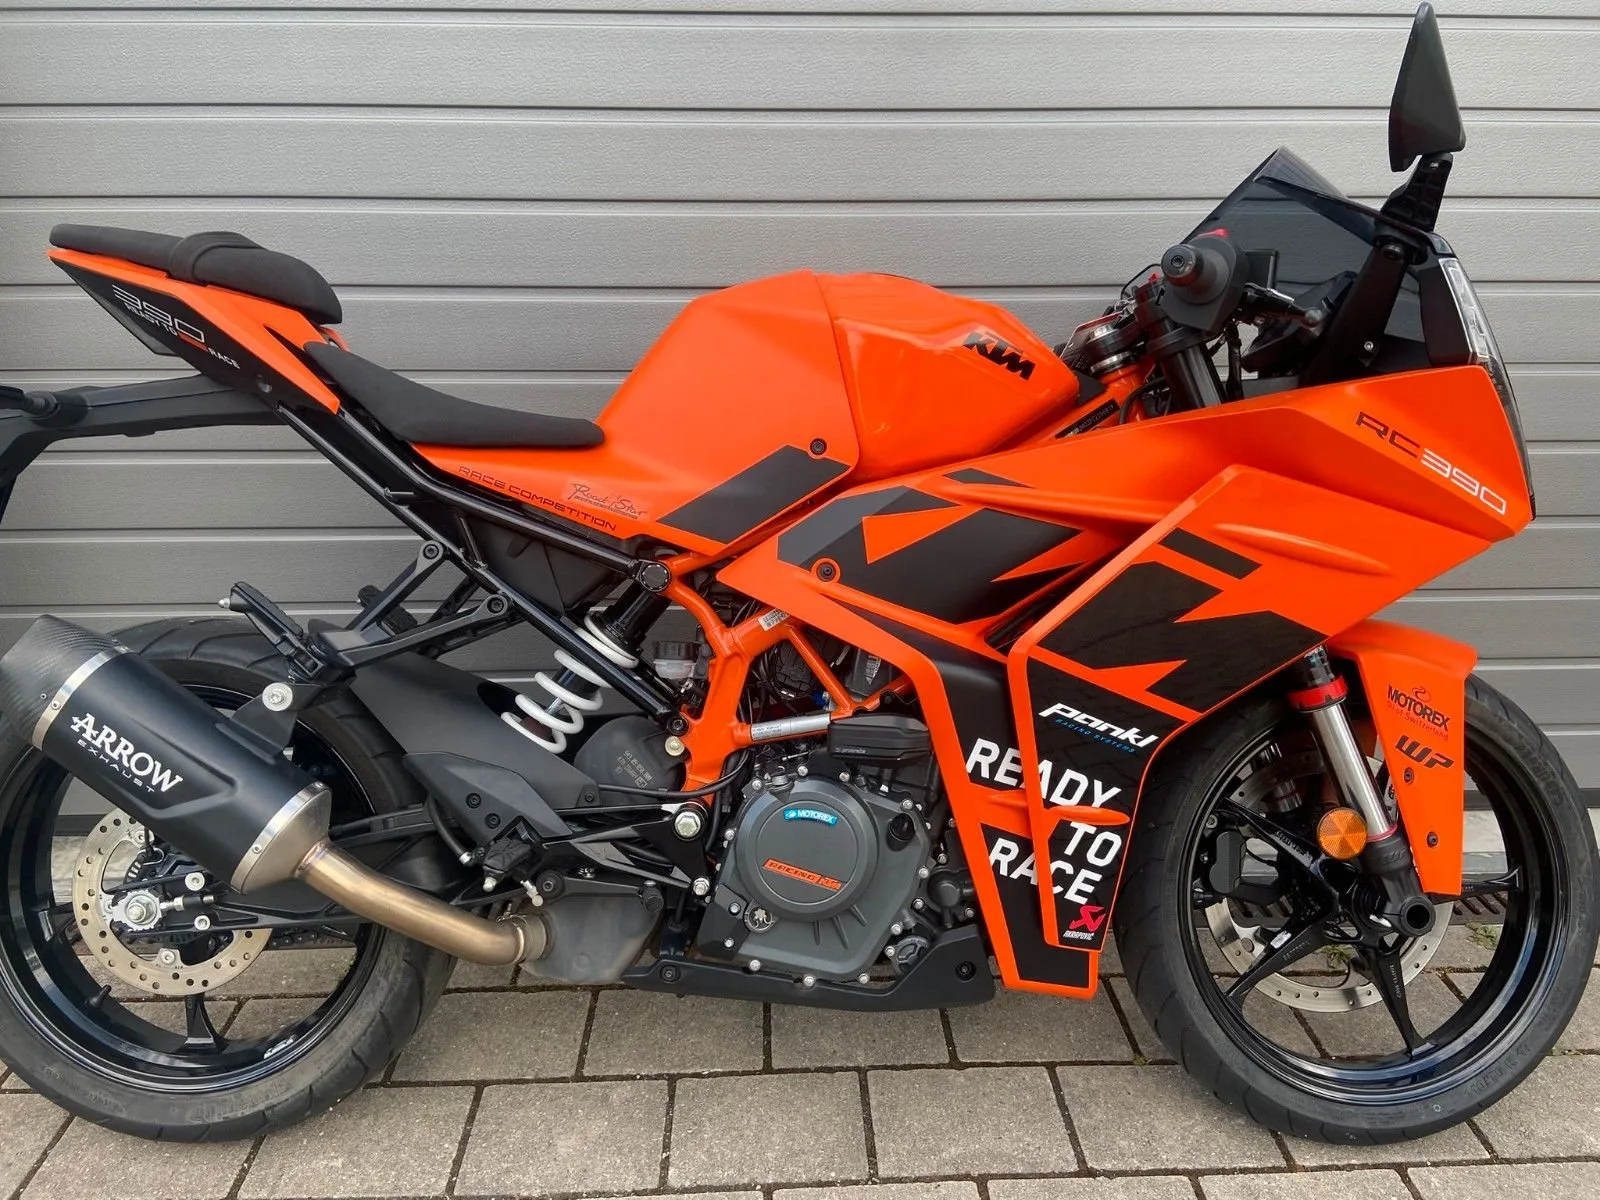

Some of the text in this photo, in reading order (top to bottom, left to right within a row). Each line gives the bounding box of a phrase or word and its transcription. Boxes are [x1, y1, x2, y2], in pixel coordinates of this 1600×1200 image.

[112, 284, 205, 343] 390
[207, 346, 240, 370] RACE
[962, 331, 1036, 382] KTM
[458, 466, 507, 490] RACE
[508, 485, 617, 532] COMPETITION
[1388, 684, 1450, 732] MOTOREX
[70, 712, 184, 792] ARROW
[1055, 719, 1136, 753] RACING SYSTEMS
[1395, 735, 1454, 768] WP
[77, 739, 155, 793] EXHAUST
[966, 737, 1122, 808] READY
[797, 809, 834, 824] MOTOREX
[1064, 820, 1122, 868] TO
[768, 861, 816, 881] RACING
[989, 837, 1103, 905] RACE
